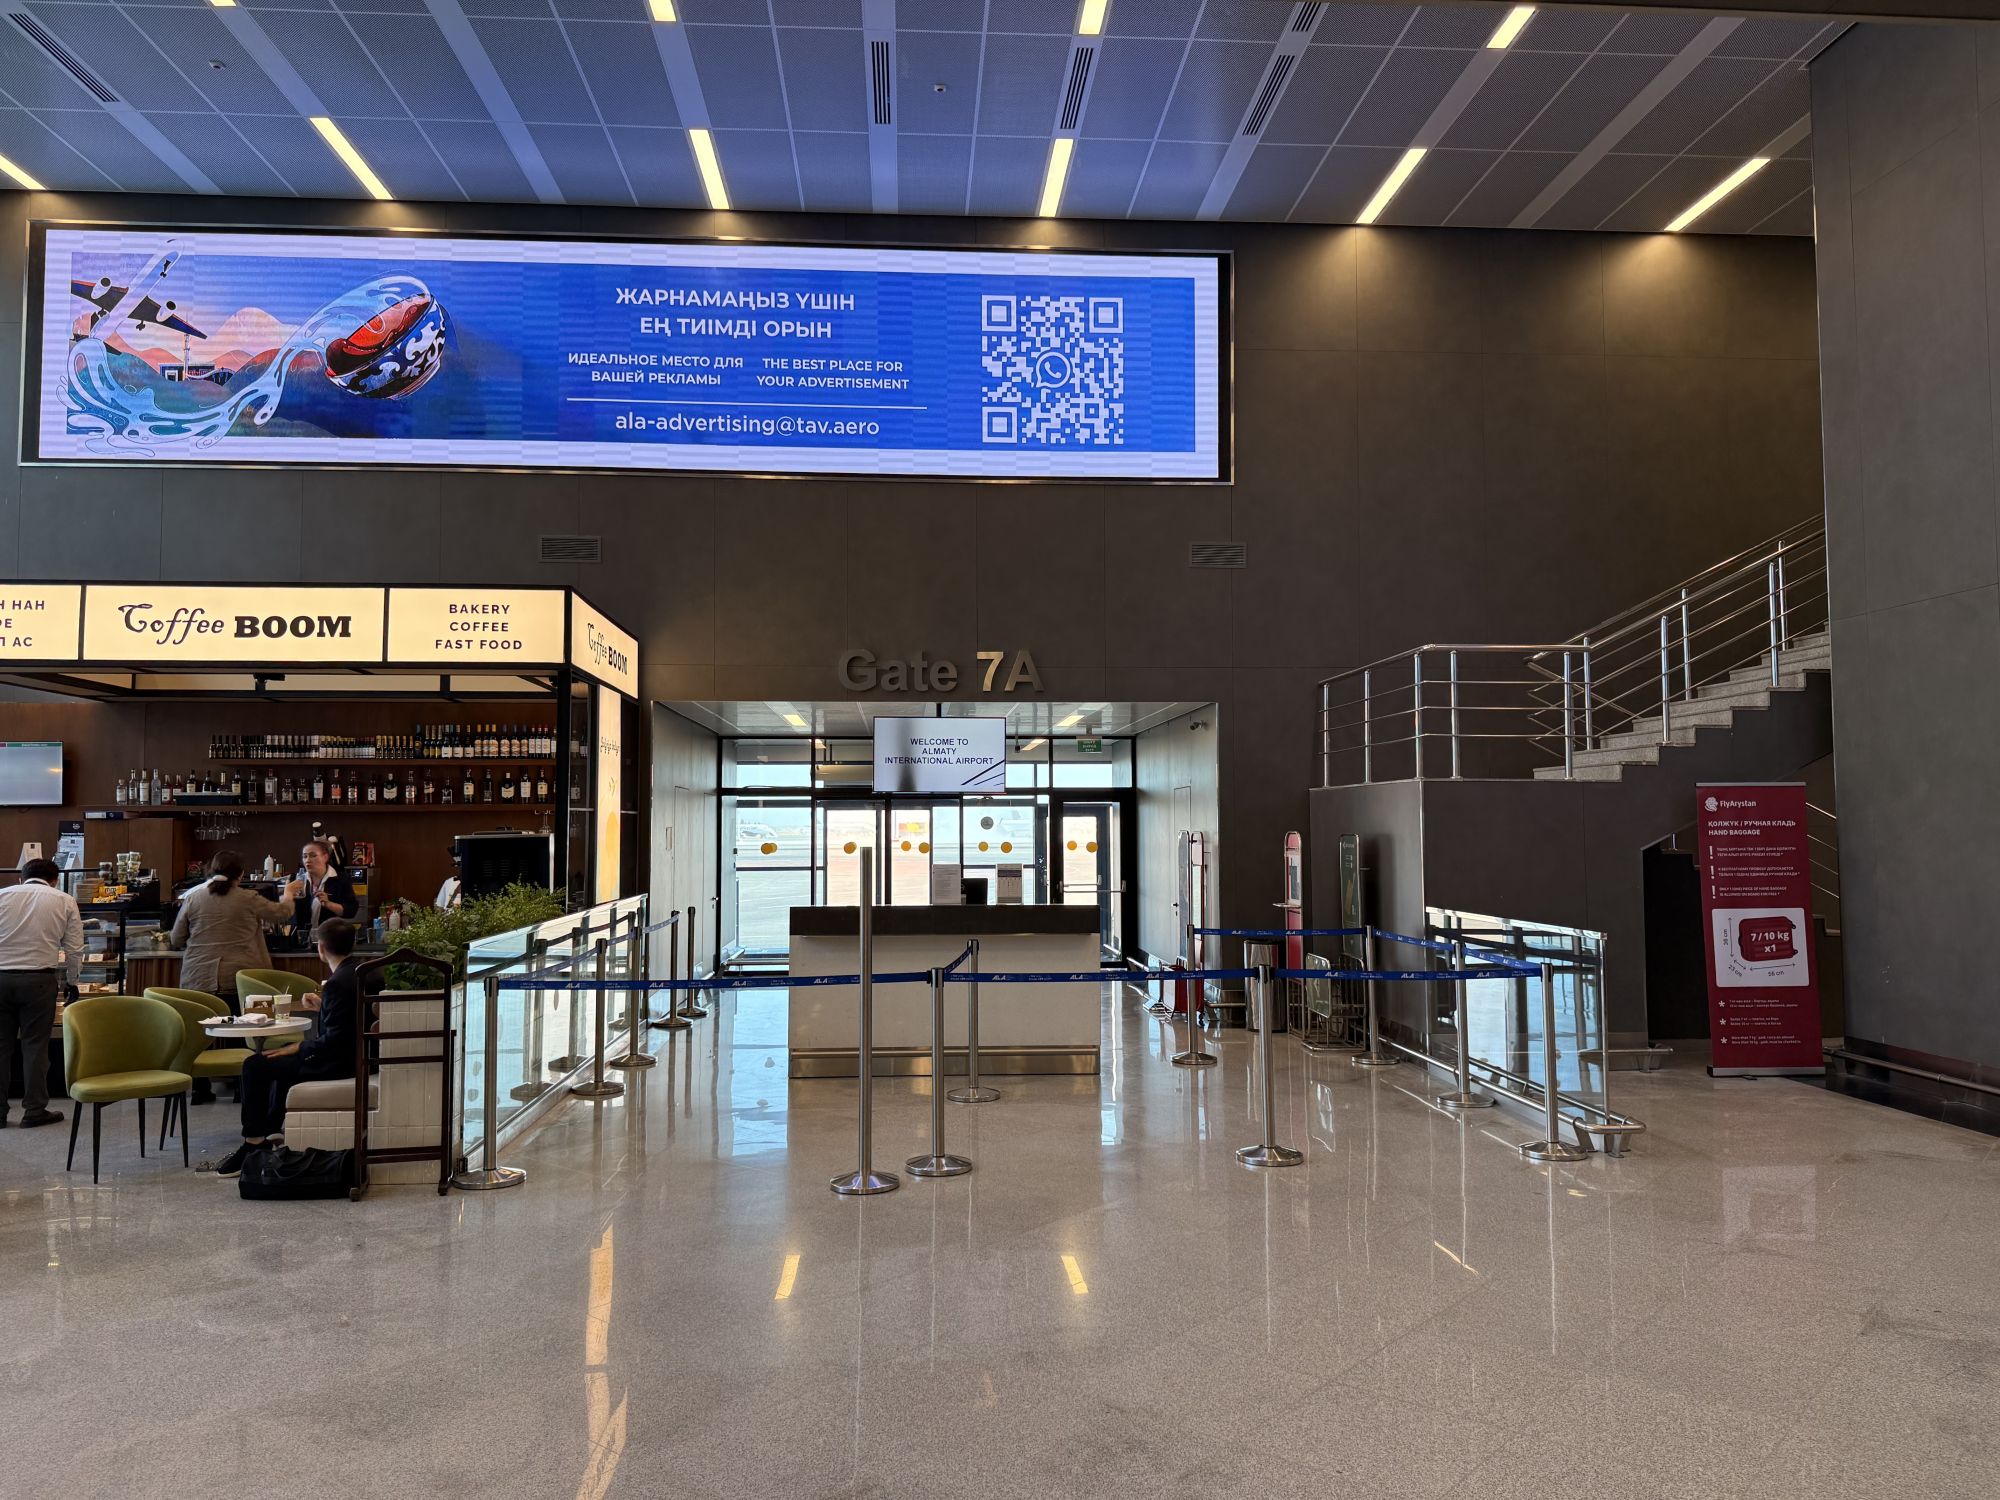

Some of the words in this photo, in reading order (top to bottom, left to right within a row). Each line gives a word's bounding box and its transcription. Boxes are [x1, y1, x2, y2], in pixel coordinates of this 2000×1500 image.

[616, 287, 790, 310] ЖАРНАМАҢЫЗ
[796, 293, 855, 311] ҮШІН
[640, 317, 671, 337] ЕҢ
[677, 318, 757, 339] ТИІМДІ
[763, 320, 832, 338] ОРЫН
[568, 352, 658, 366] ИДЕАЛЬНОЕ
[662, 355, 710, 367] МЕСТО
[714, 357, 743, 369] ДЛЯ
[762, 358, 788, 369] THE
[793, 359, 826, 370] BEST
[830, 360, 872, 371] PLACE
[876, 361, 903, 372] FOR
[591, 370, 644, 383] ВАШЕЙ
[649, 372, 721, 385] РЕКЛАМЫ
[757, 376, 794, 387] YOUR
[798, 377, 909, 389] ADVERTISEMENT
[615, 412, 879, 436] ala-advertising@tav.aero
[449, 604, 510, 614] BAKERY
[118, 603, 224, 645] Coffee
[234, 616, 352, 638] BOOM
[449, 622, 509, 632] COFFEE
[435, 640, 473, 650] FAST
[480, 640, 522, 650] FOOD
[587, 622, 608, 665] Coffee
[608, 646, 627, 675] BOOM
[838, 650, 958, 692] Gate
[976, 650, 1044, 692] 7A
[1720, 800, 1757, 809] FlyArystan
[1751, 933, 1757, 941] 7
[1764, 932, 1775, 940] 10
[1777, 931, 1790, 941] kg
[1764, 944, 1776, 953] x1
